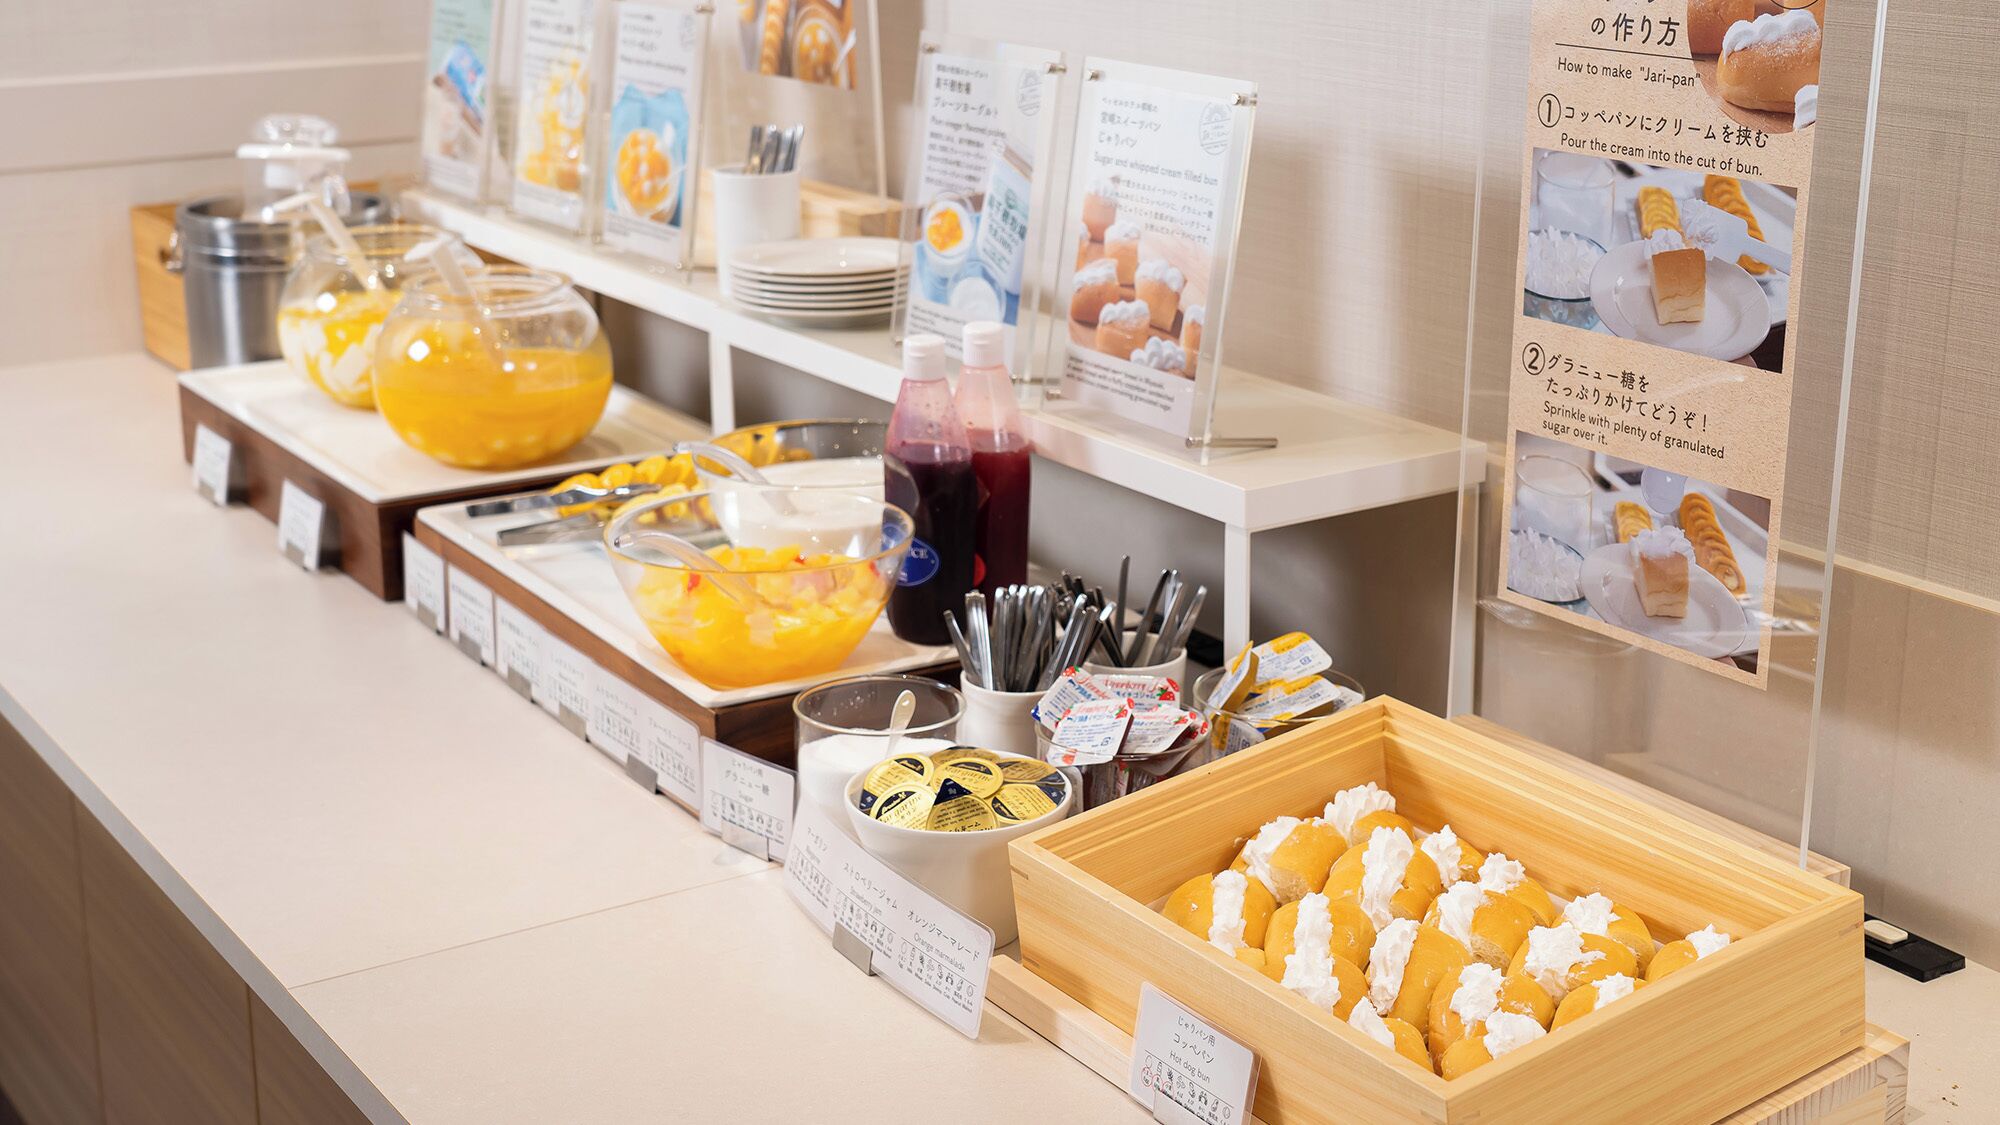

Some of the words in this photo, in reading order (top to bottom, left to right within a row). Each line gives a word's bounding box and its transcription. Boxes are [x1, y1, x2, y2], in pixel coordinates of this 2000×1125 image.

[1590, 12, 1681, 47] の作り方
[1557, 57, 1583, 73] How
[1586, 61, 1599, 75] to
[1601, 62, 1633, 79] make
[1639, 66, 1701, 88] "Jari-pan"
[1094, 152, 1114, 167] Sugar
[1115, 157, 1128, 168] and
[1129, 160, 1160, 176] whipped
[1161, 167, 1182, 178] cream
[1183, 169, 1202, 184] filled
[1204, 174, 1218, 186] bun
[1560, 132, 1586, 150] Pour
[1590, 136, 1607, 152] the
[1610, 141, 1644, 158] cream
[1647, 145, 1671, 162] into
[1674, 150, 1693, 166] the
[1697, 154, 1716, 170] cut
[1719, 158, 1733, 173] of
[1736, 160, 1763, 176] bun.
[1547, 353, 1650, 393] グラニュー糖を
[1542, 419, 1570, 437] sugar
[1573, 428, 1595, 442] over
[1597, 431, 1608, 446] it.
[1543, 400, 1586, 423] Sprinkle
[1588, 413, 1610, 429] with
[1613, 419, 1647, 442] plenty
[1650, 430, 1662, 443] of
[1664, 434, 1725, 459] granulated
[843, 861, 899, 910] ストロベリージャム
[907, 909, 980, 962] オレンジマーマレード
[913, 932, 934, 953] Orange
[934, 947, 966, 973] marmalade
[1173, 1033, 1215, 1064] コッペパン
[1177, 1015, 1216, 1047] じゃりパン用
[1169, 1050, 1182, 1064] Hot
[1183, 1059, 1196, 1077] dog
[1197, 1064, 1211, 1083] bun
